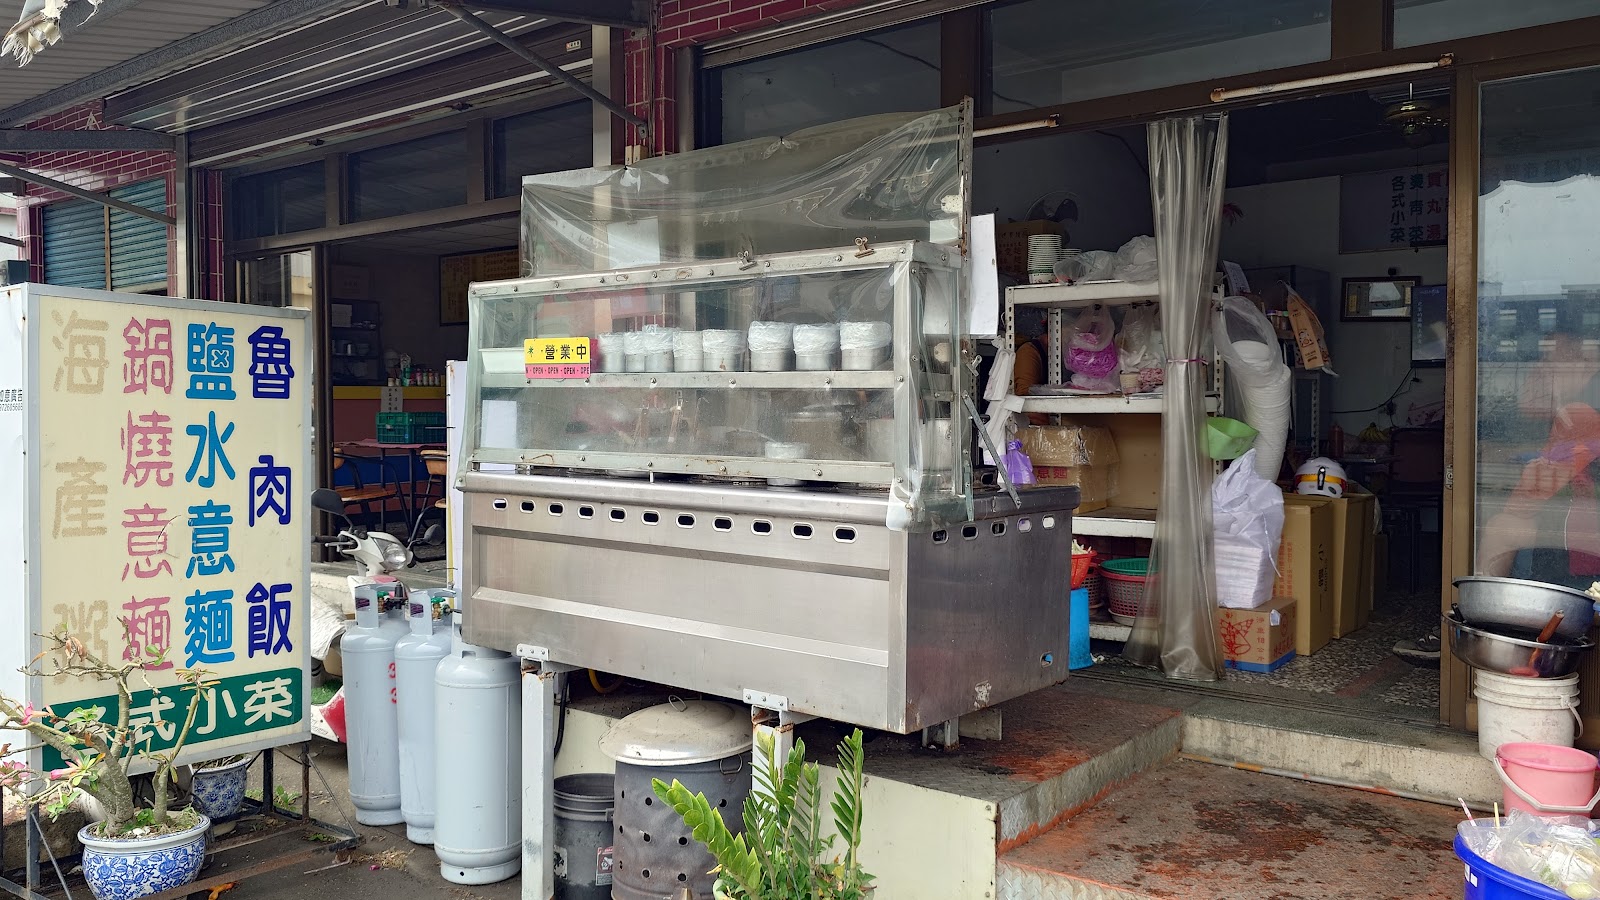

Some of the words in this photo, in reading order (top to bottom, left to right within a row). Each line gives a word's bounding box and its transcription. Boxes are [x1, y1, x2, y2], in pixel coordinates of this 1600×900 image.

[1390, 175, 1406, 243] 各式小菜
[545, 344, 587, 360] 營業中
[563, 367, 576, 375] OPEN
[121, 317, 174, 671] 鍋燒意麵
[184, 321, 236, 668] 鹽水意麵
[246, 325, 295, 659] 魯肉飯
